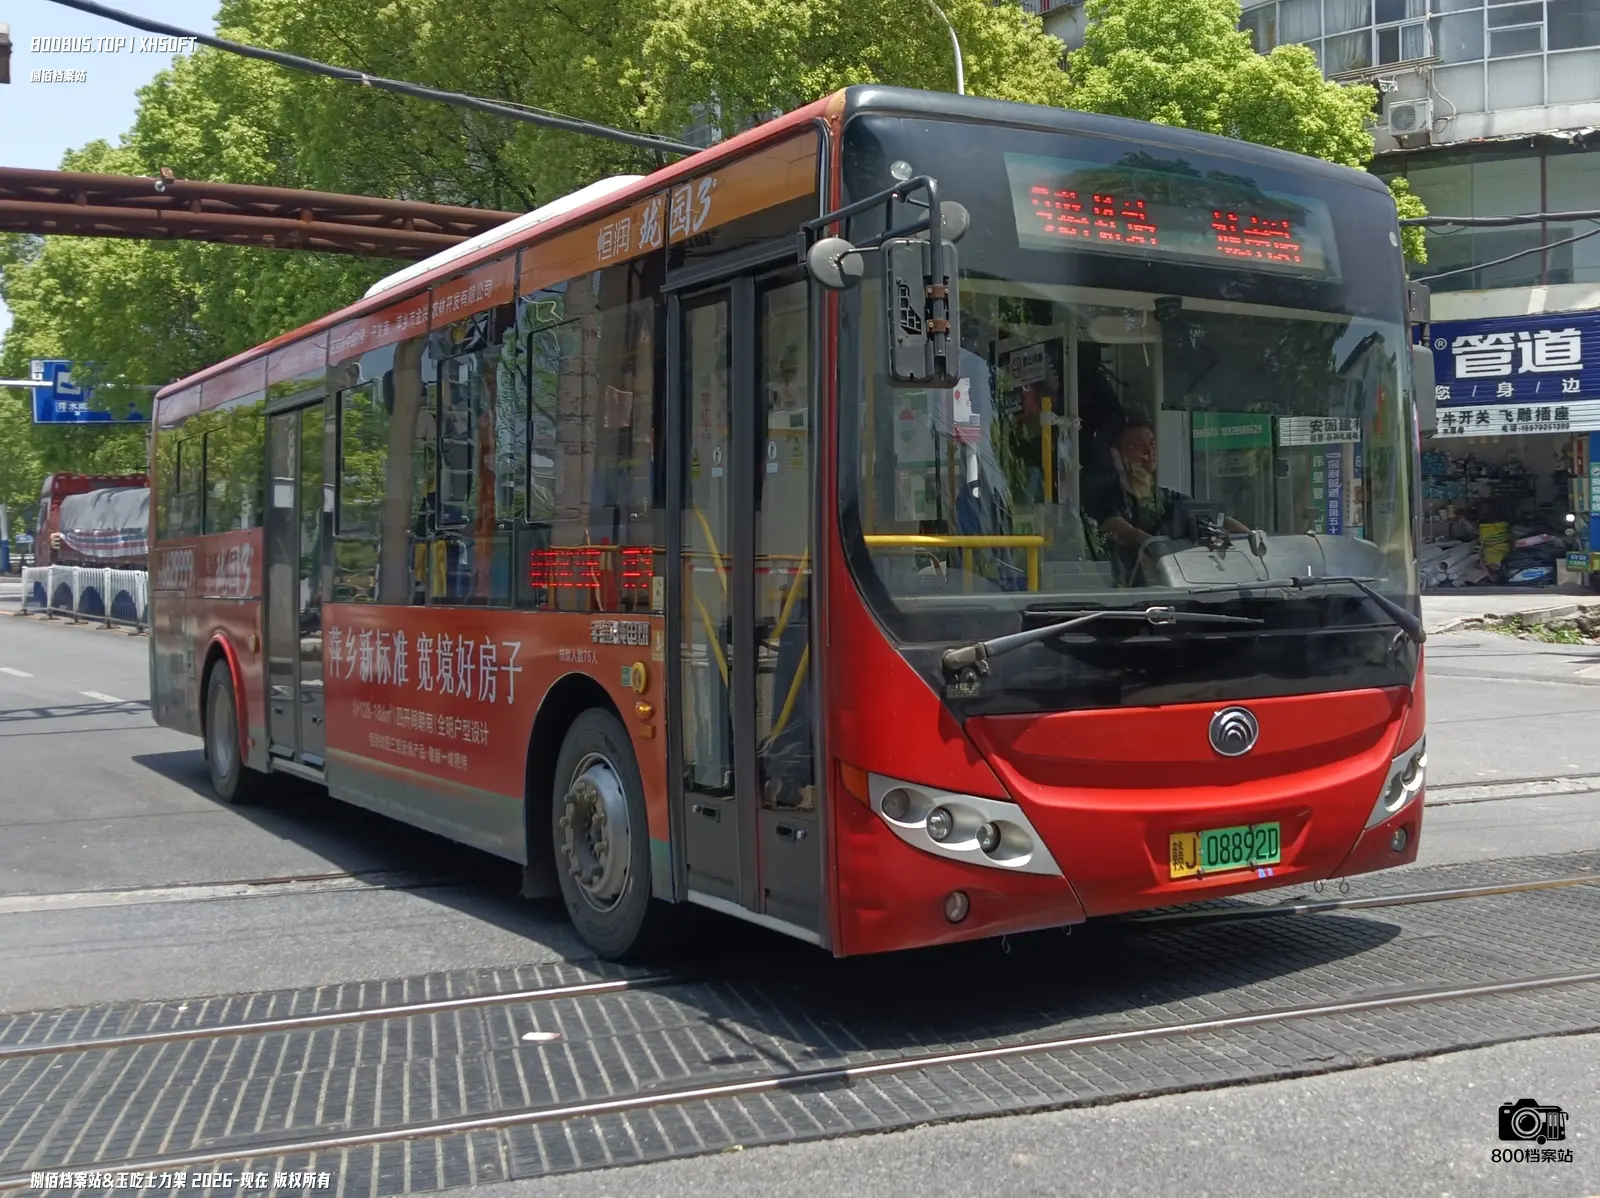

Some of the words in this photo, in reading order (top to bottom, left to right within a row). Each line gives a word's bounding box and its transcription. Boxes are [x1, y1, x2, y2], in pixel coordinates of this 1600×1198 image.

[1452, 328, 1583, 378] 管道
[1436, 410, 1490, 426] 牛开关
[1499, 406, 1570, 423] 飞雕插座
[329, 626, 409, 687] 萍乡新标准
[416, 632, 523, 705] 宽境好房子
